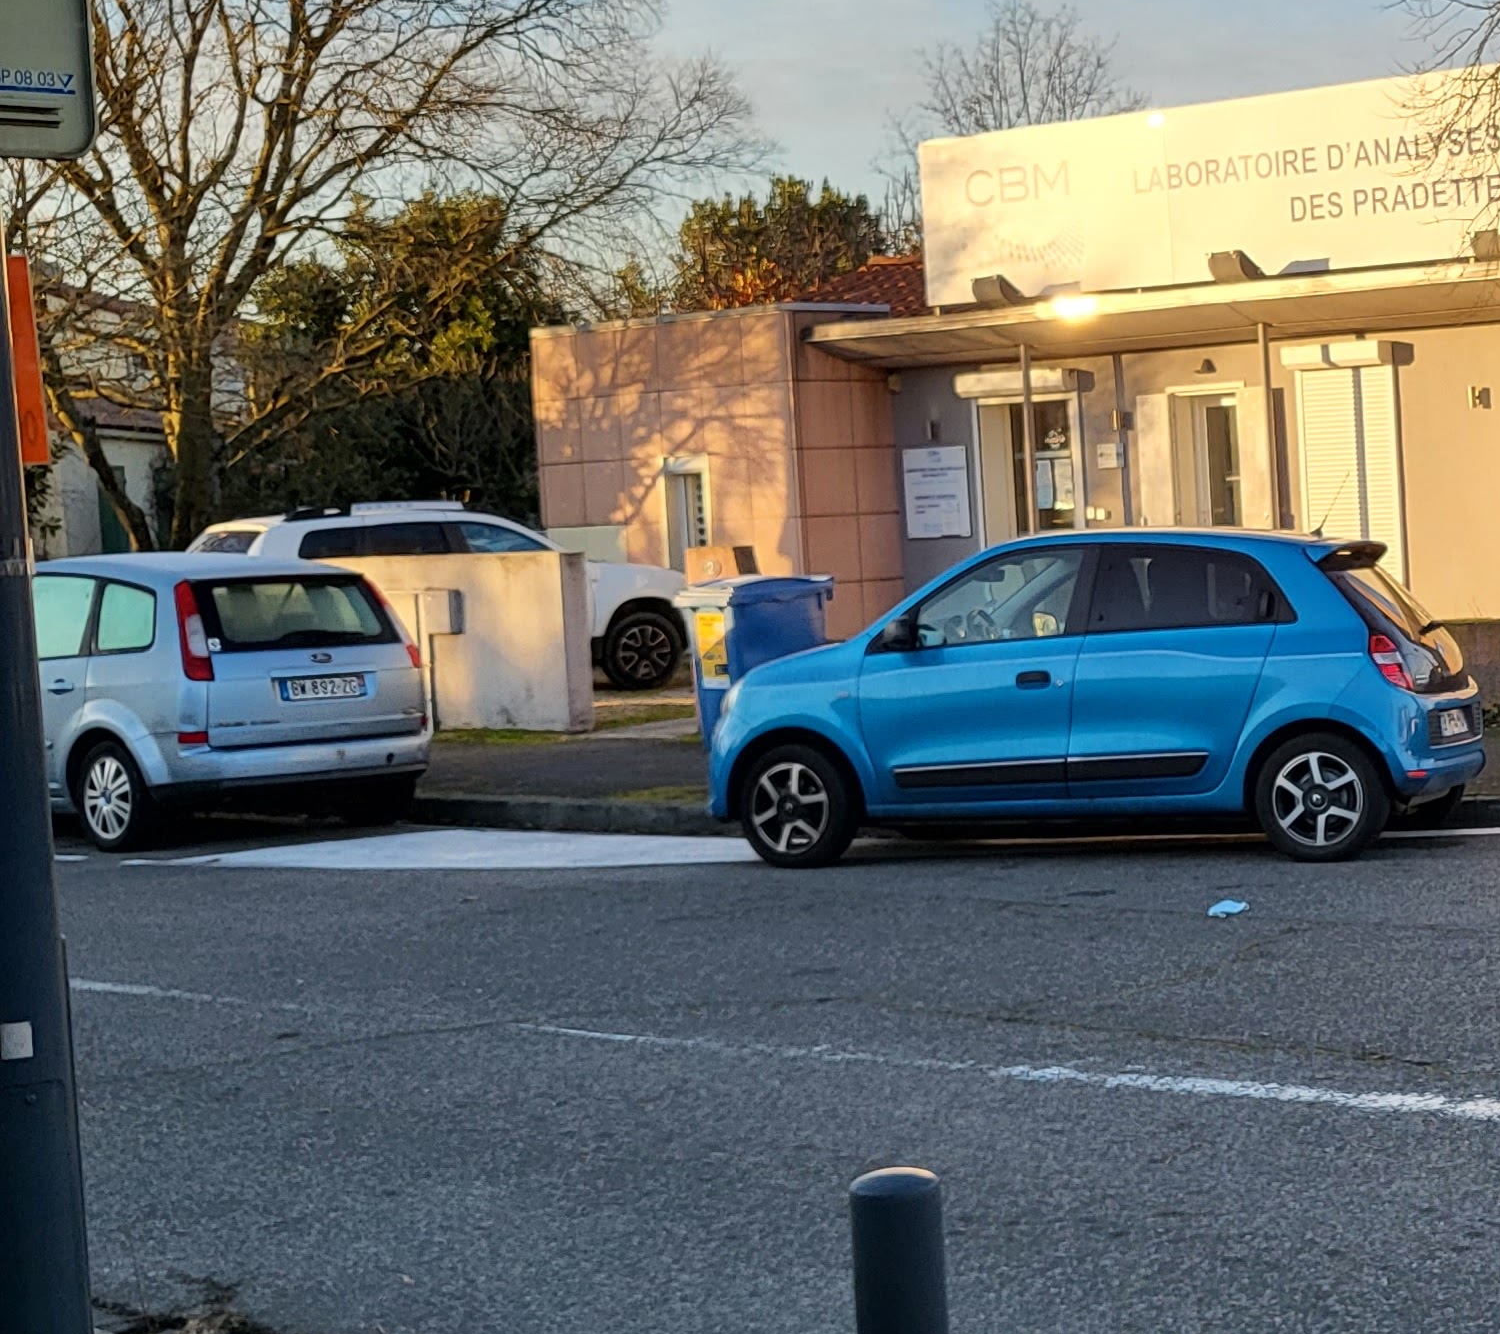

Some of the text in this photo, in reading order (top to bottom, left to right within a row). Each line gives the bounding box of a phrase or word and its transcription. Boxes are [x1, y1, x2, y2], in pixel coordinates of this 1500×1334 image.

[14, 70, 33, 86] 08
[37, 72, 56, 87] 03
[965, 160, 1070, 208] CBM
[1133, 147, 1318, 194] LABORATOIRE
[1290, 191, 1344, 223] DES
